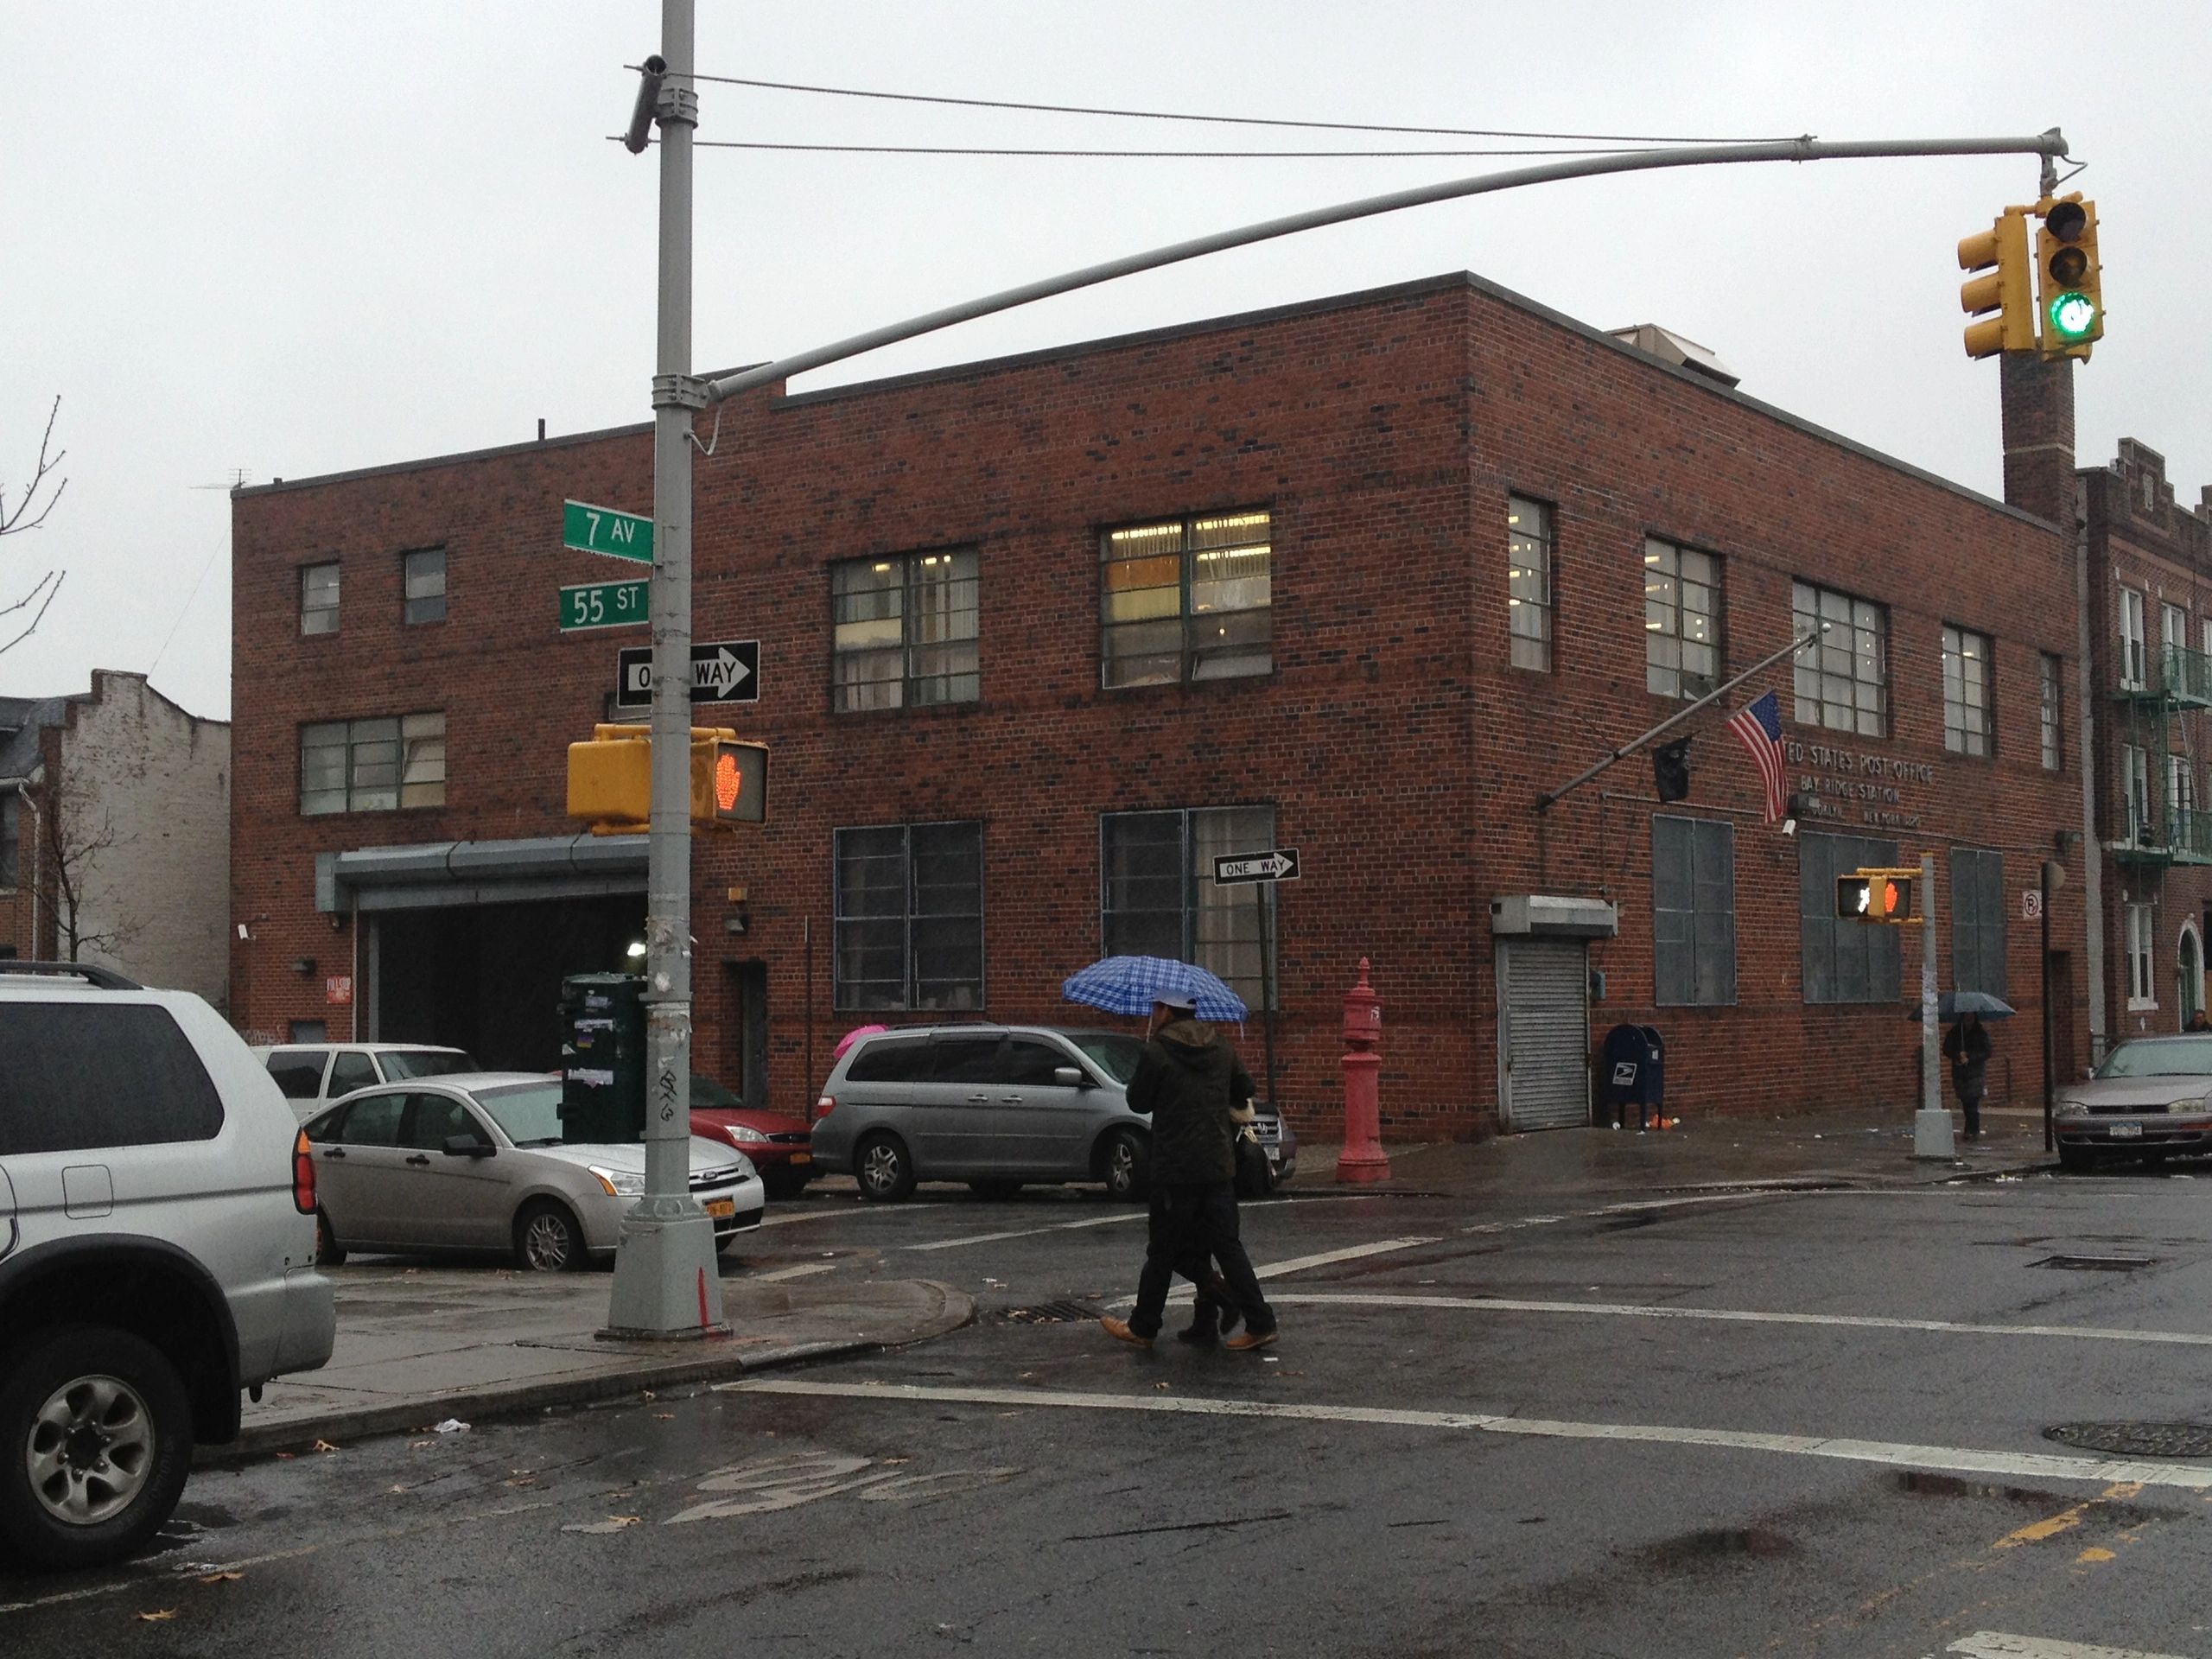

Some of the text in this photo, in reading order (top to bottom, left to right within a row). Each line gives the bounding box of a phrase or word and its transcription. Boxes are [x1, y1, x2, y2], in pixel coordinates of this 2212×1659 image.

[586, 512, 635, 546] 7 AV
[574, 587, 639, 624] 55 ST
[696, 662, 736, 684] WAY
[1810, 746, 1853, 770] STATES
[1860, 754, 1888, 775] POST
[1894, 761, 1933, 783] OFFICE
[1801, 775, 1900, 802] BAY RIDGE STATION
[1226, 859, 1285, 875] ONE WAY
